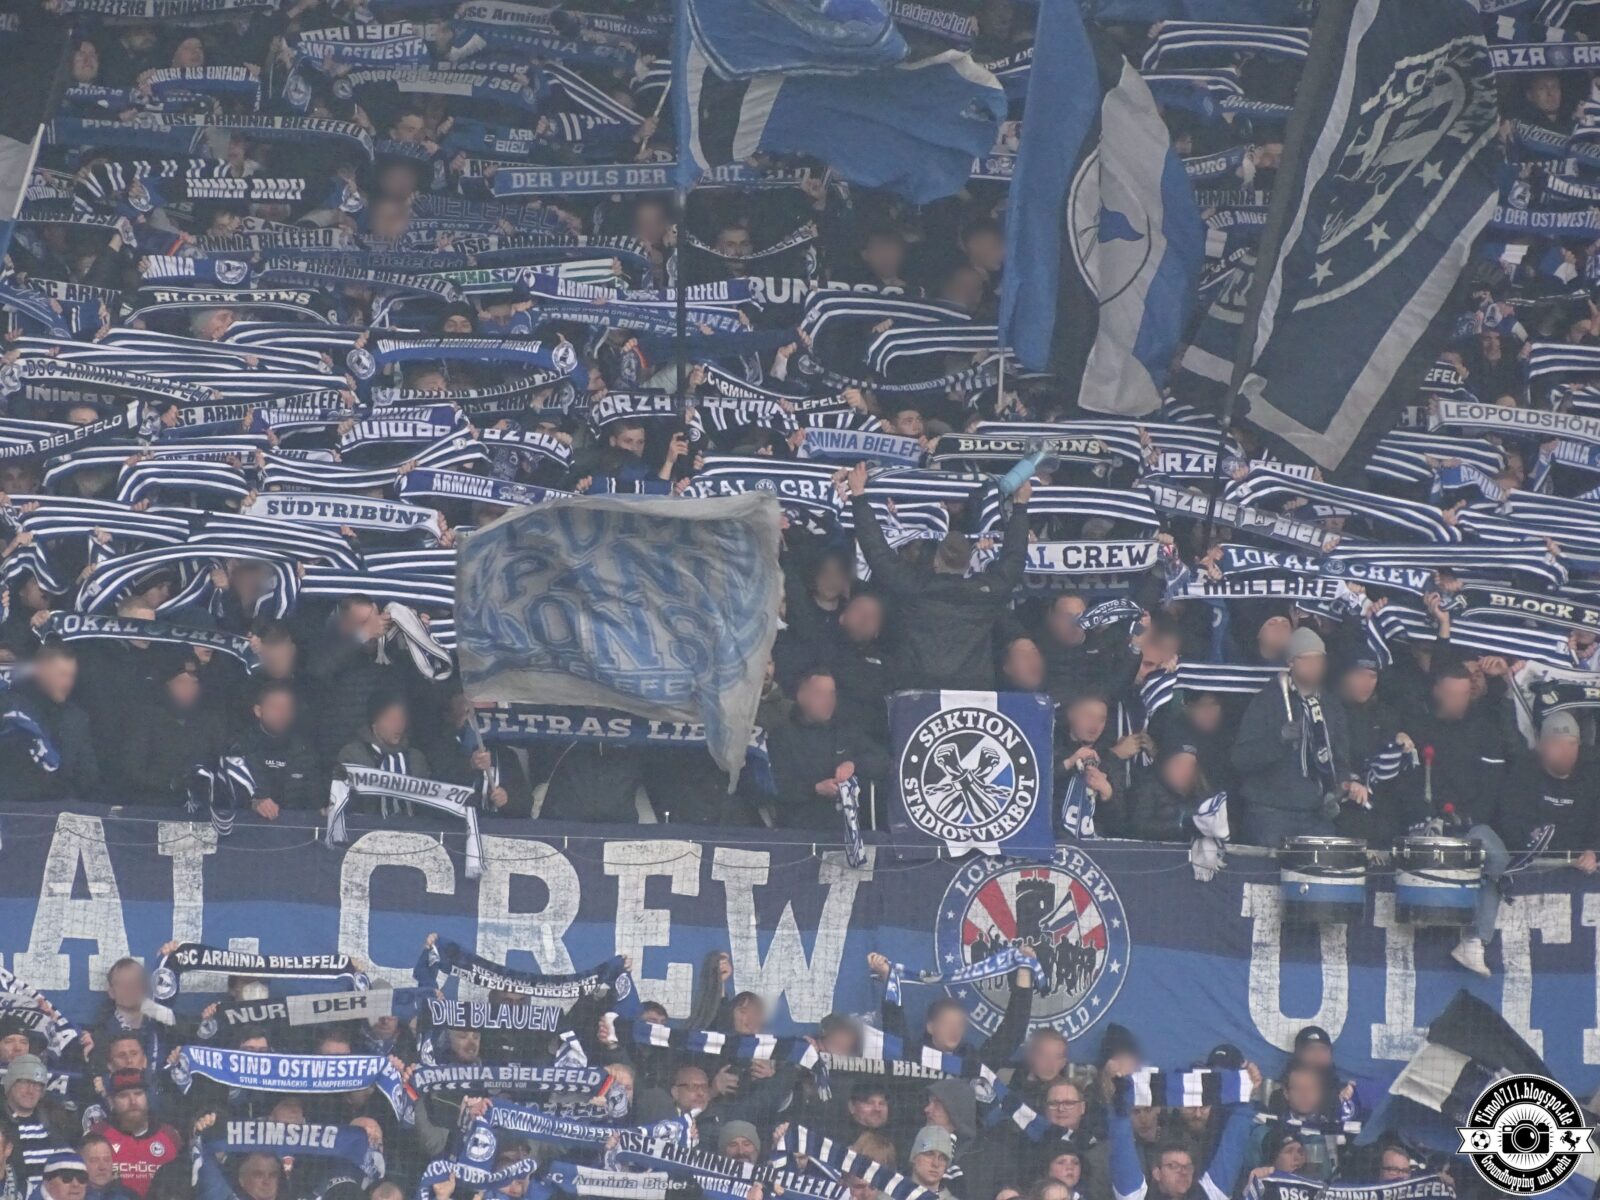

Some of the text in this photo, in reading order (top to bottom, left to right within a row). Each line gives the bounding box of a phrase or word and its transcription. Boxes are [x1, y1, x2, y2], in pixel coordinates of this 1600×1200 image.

[511, 168, 668, 189] DER PULS DER
[252, 291, 311, 306] EINS
[39, 414, 122, 454] BIELEFELD
[432, 474, 494, 498] ARMINIA
[1062, 543, 1153, 570] CREW
[1228, 549, 1432, 590] LOKAL CREW
[1490, 593, 1574, 619] BLOCK
[918, 710, 1021, 751] SEKTION
[902, 776, 1036, 843] STADIONVERBOT
[336, 826, 876, 1028] CREW
[201, 951, 264, 969] ARMINIA
[269, 954, 350, 971] BIELEFELD
[225, 993, 368, 1026] NUR DER
[427, 998, 562, 1033] DIE BLAUEN
[189, 1047, 224, 1071] WIR
[228, 1054, 272, 1077] SIND
[312, 1079, 364, 1089] KÄMPFERISCH
[414, 1067, 600, 1088] ARMINIA BIELEFELD
[226, 1120, 339, 1149] HEIMSIEG
[661, 1141, 745, 1178] ARMINIA
